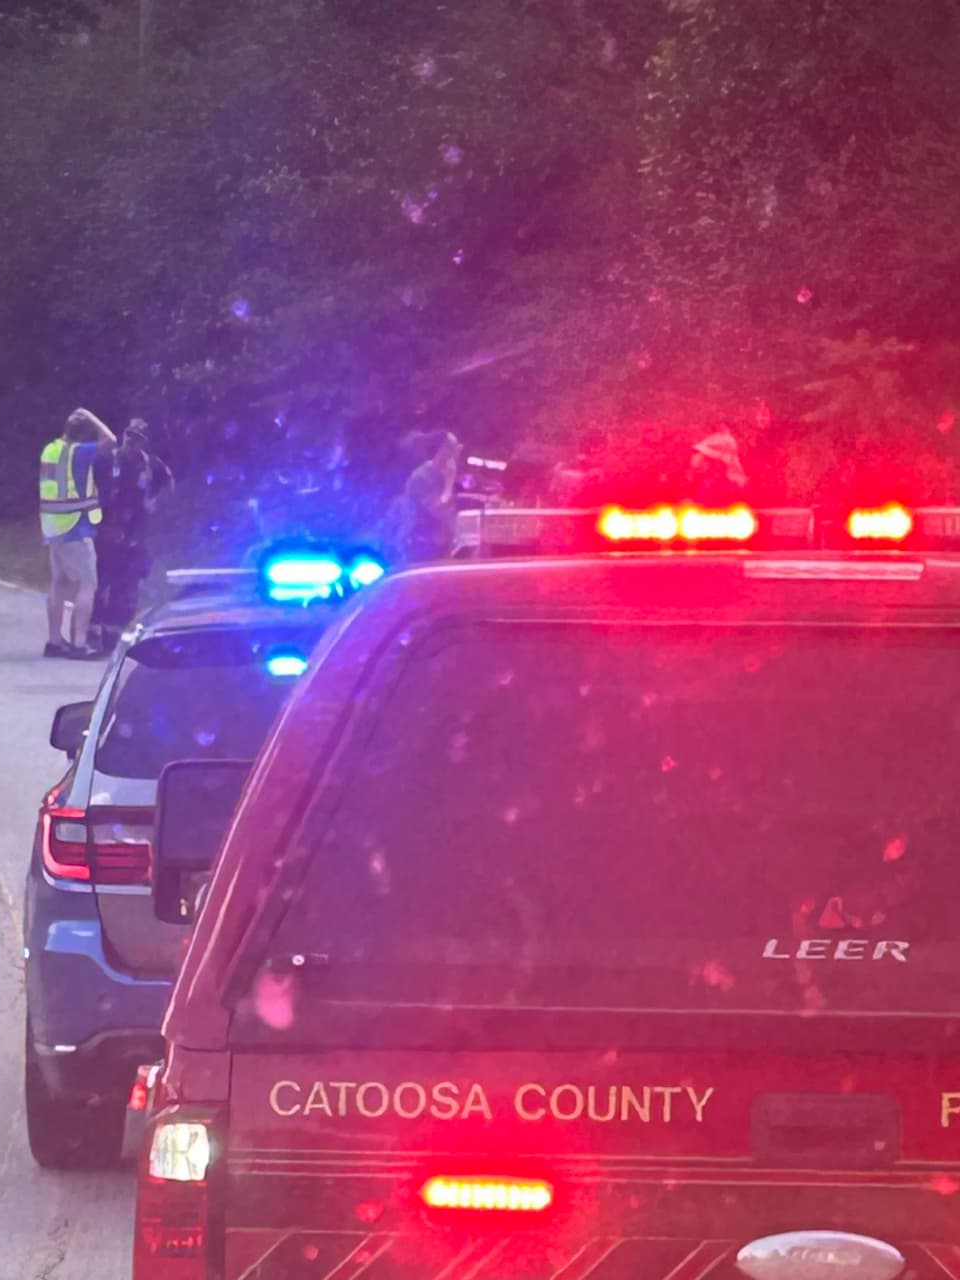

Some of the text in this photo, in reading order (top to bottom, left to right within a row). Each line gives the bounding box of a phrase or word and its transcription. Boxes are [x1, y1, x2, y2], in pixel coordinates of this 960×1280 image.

[762, 938, 910, 962] LEER
[269, 1079, 493, 1120] CATOOSA
[514, 1083, 714, 1123] COUNTY
